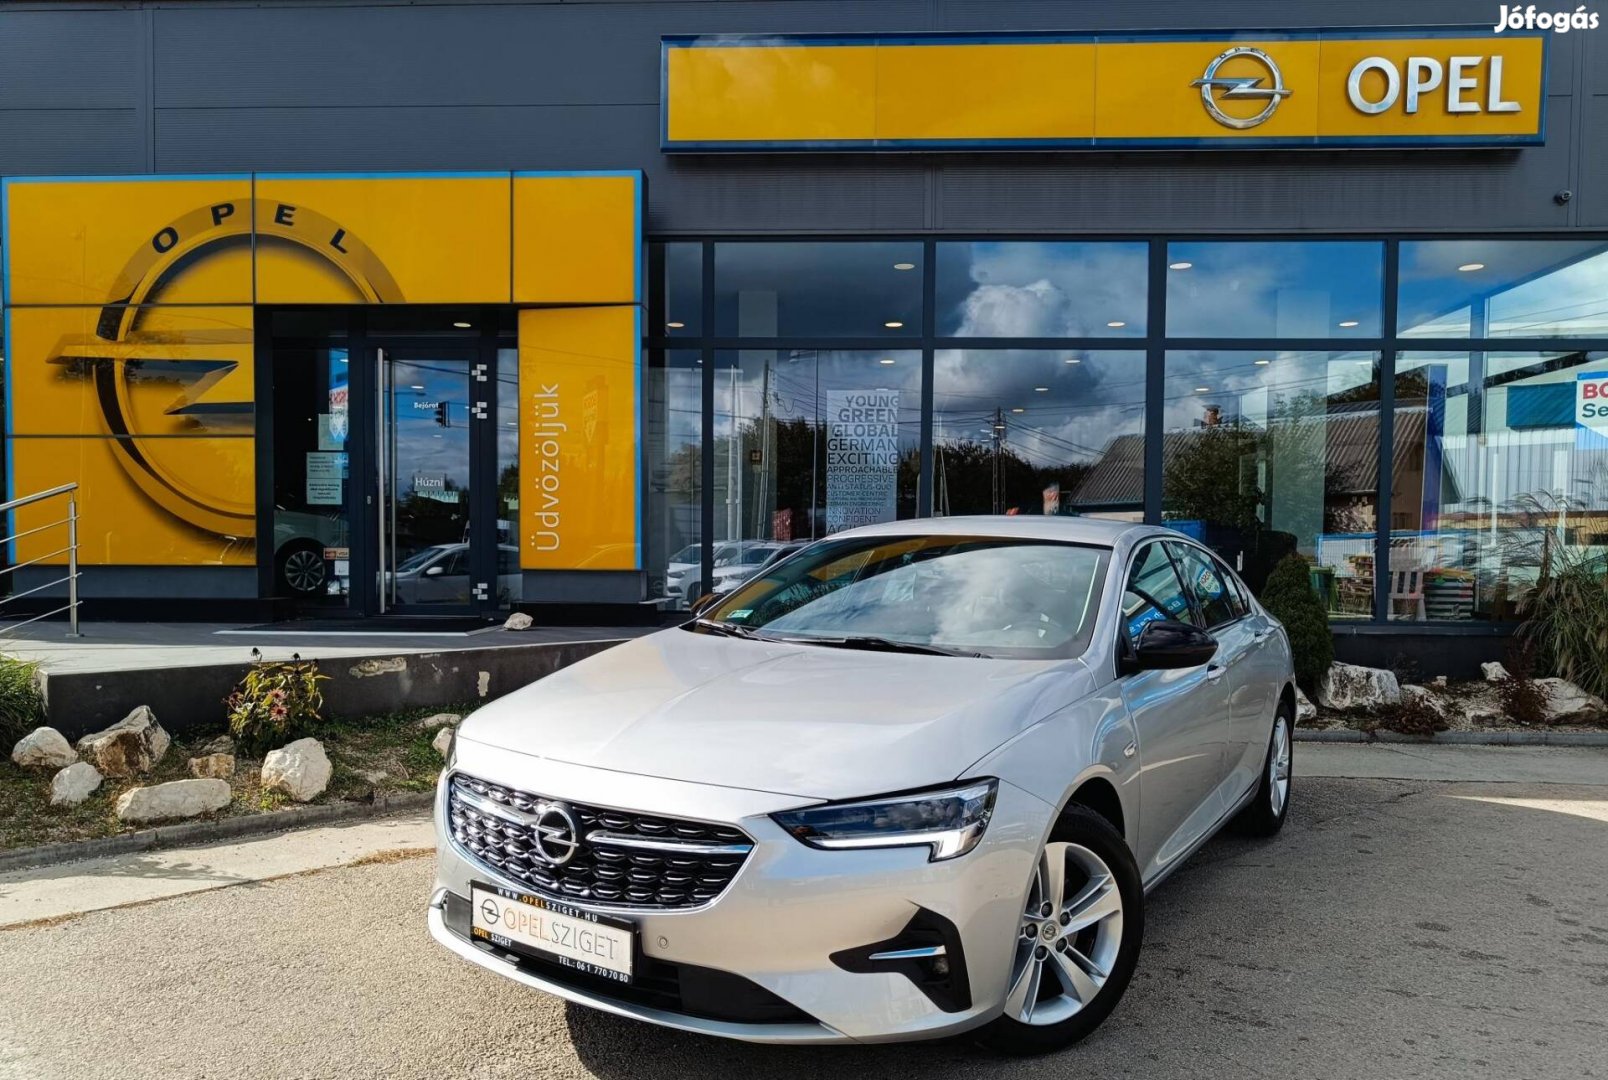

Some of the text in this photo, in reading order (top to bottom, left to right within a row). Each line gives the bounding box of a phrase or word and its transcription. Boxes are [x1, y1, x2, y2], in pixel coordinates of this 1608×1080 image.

[1348, 56, 1522, 114] OPEL
[152, 203, 348, 254] OPEL
[845, 395, 899, 408] YOUNG
[838, 408, 898, 422] GREEN
[832, 424, 898, 437] GLOBAL
[827, 438, 898, 451] GERMAN
[828, 453, 898, 465] EXCITING
[531, 384, 567, 551] Üdvözöljük
[415, 477, 443, 487] Húzni
[827, 475, 894, 483] PROGRESSIVE
[498, 887, 598, 922] WWW.OPELSZIGET.HU
[491, 933, 512, 946] SZIGET
